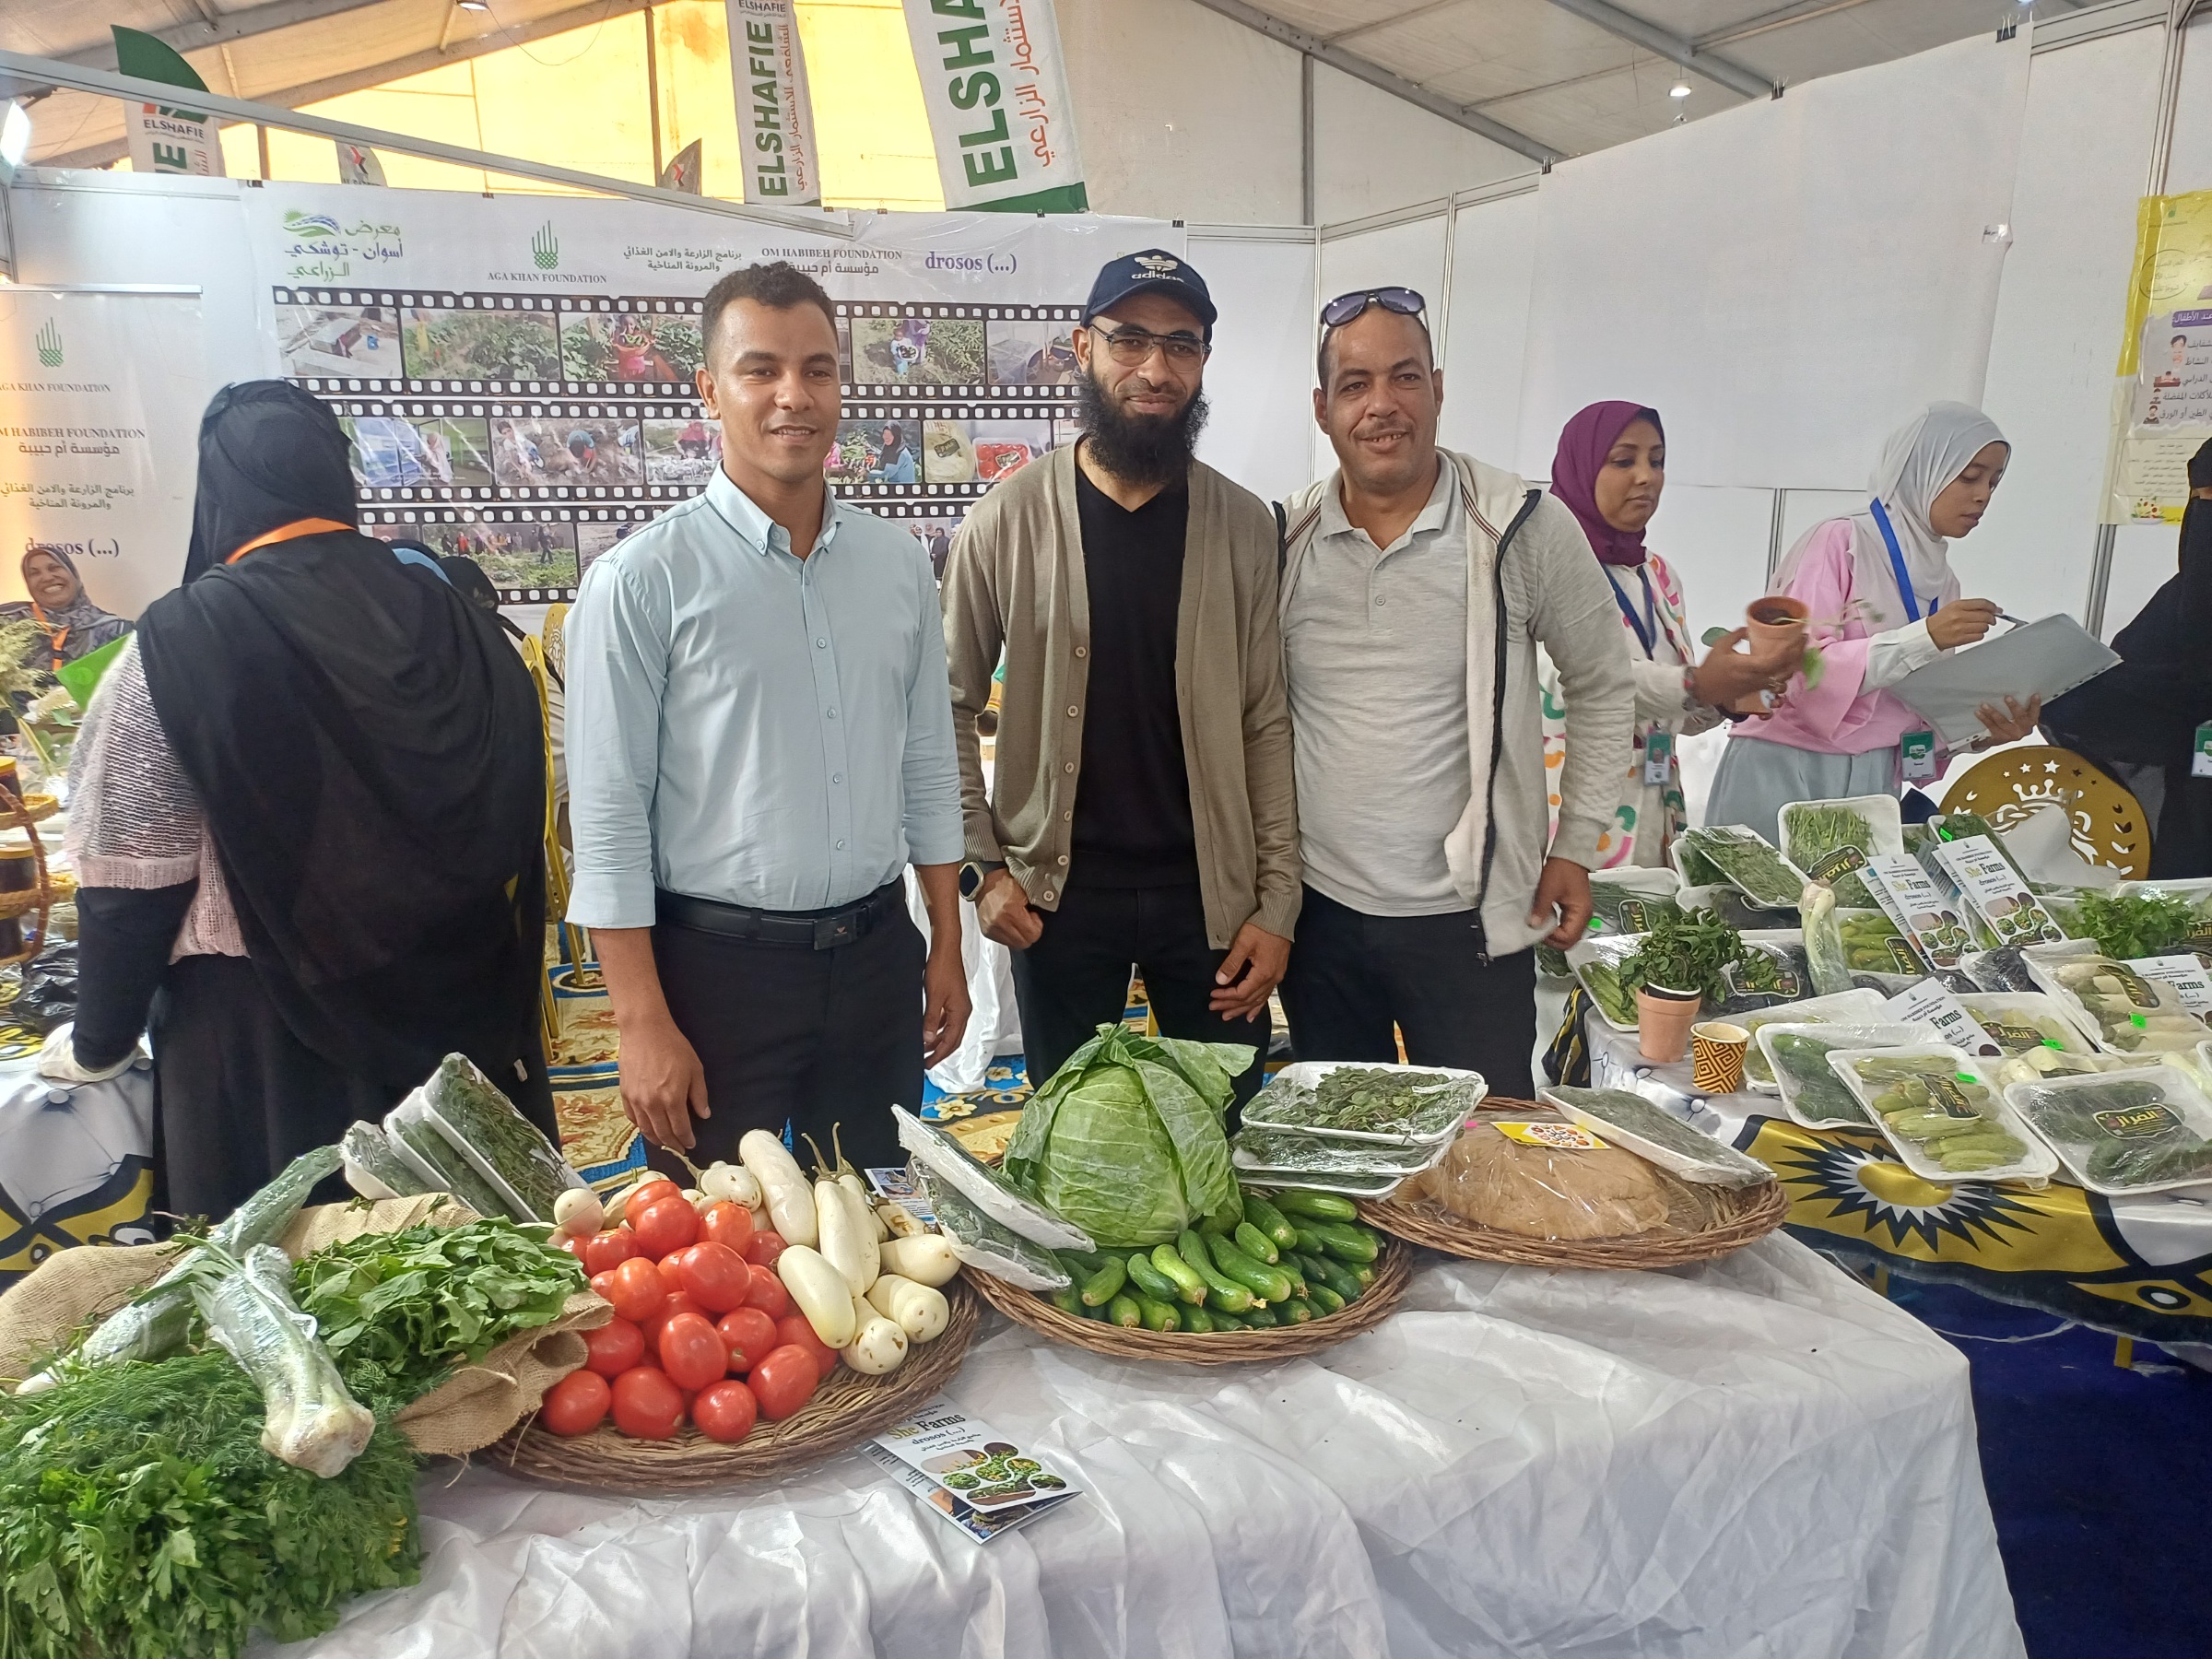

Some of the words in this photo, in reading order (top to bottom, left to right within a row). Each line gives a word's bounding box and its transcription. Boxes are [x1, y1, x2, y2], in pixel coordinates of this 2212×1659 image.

[739, 0, 786, 13] ELSHAFIE
[746, 20, 788, 196] ELSHAFIE
[144, 119, 205, 138] ELSHAFIE
[1015, 84, 1056, 168] الزراعي
[790, 144, 807, 192] الزراعي
[345, 220, 401, 241] معرض
[363, 238, 404, 264] أسوان
[623, 245, 653, 260] الغذائي
[715, 249, 742, 263] برنامج
[761, 248, 780, 257] OM
[782, 248, 830, 258] HABIBEH
[833, 249, 903, 260] FOUNDATION
[647, 260, 683, 272] المناخية
[685, 262, 720, 273] والمرونة
[821, 260, 832, 277] أم
[835, 262, 880, 277] مؤسسة
[924, 251, 983, 271] drosos
[987, 253, 1018, 275] (...)
[288, 261, 350, 282] الزراعي
[488, 272, 509, 281] AGA
[511, 273, 539, 282] KHAN
[543, 274, 607, 284] FOUNDATION
[18, 382, 45, 392] KHAN
[47, 383, 112, 394] FOUNDATION
[11, 428, 65, 438] HABIBEH
[67, 429, 147, 440] FOUNDATION
[18, 442, 52, 456] حبيبة
[55, 440, 67, 458] أم
[71, 441, 120, 458] مؤسسة
[1965, 866, 1983, 878] She
[1979, 862, 2006, 875] Farms
[1905, 878, 1931, 890] Farms
[1929, 1010, 1962, 1030] Farms
[887, 1426, 920, 1440] She
[914, 1414, 966, 1431] Farms
[912, 1432, 947, 1445] drosos
